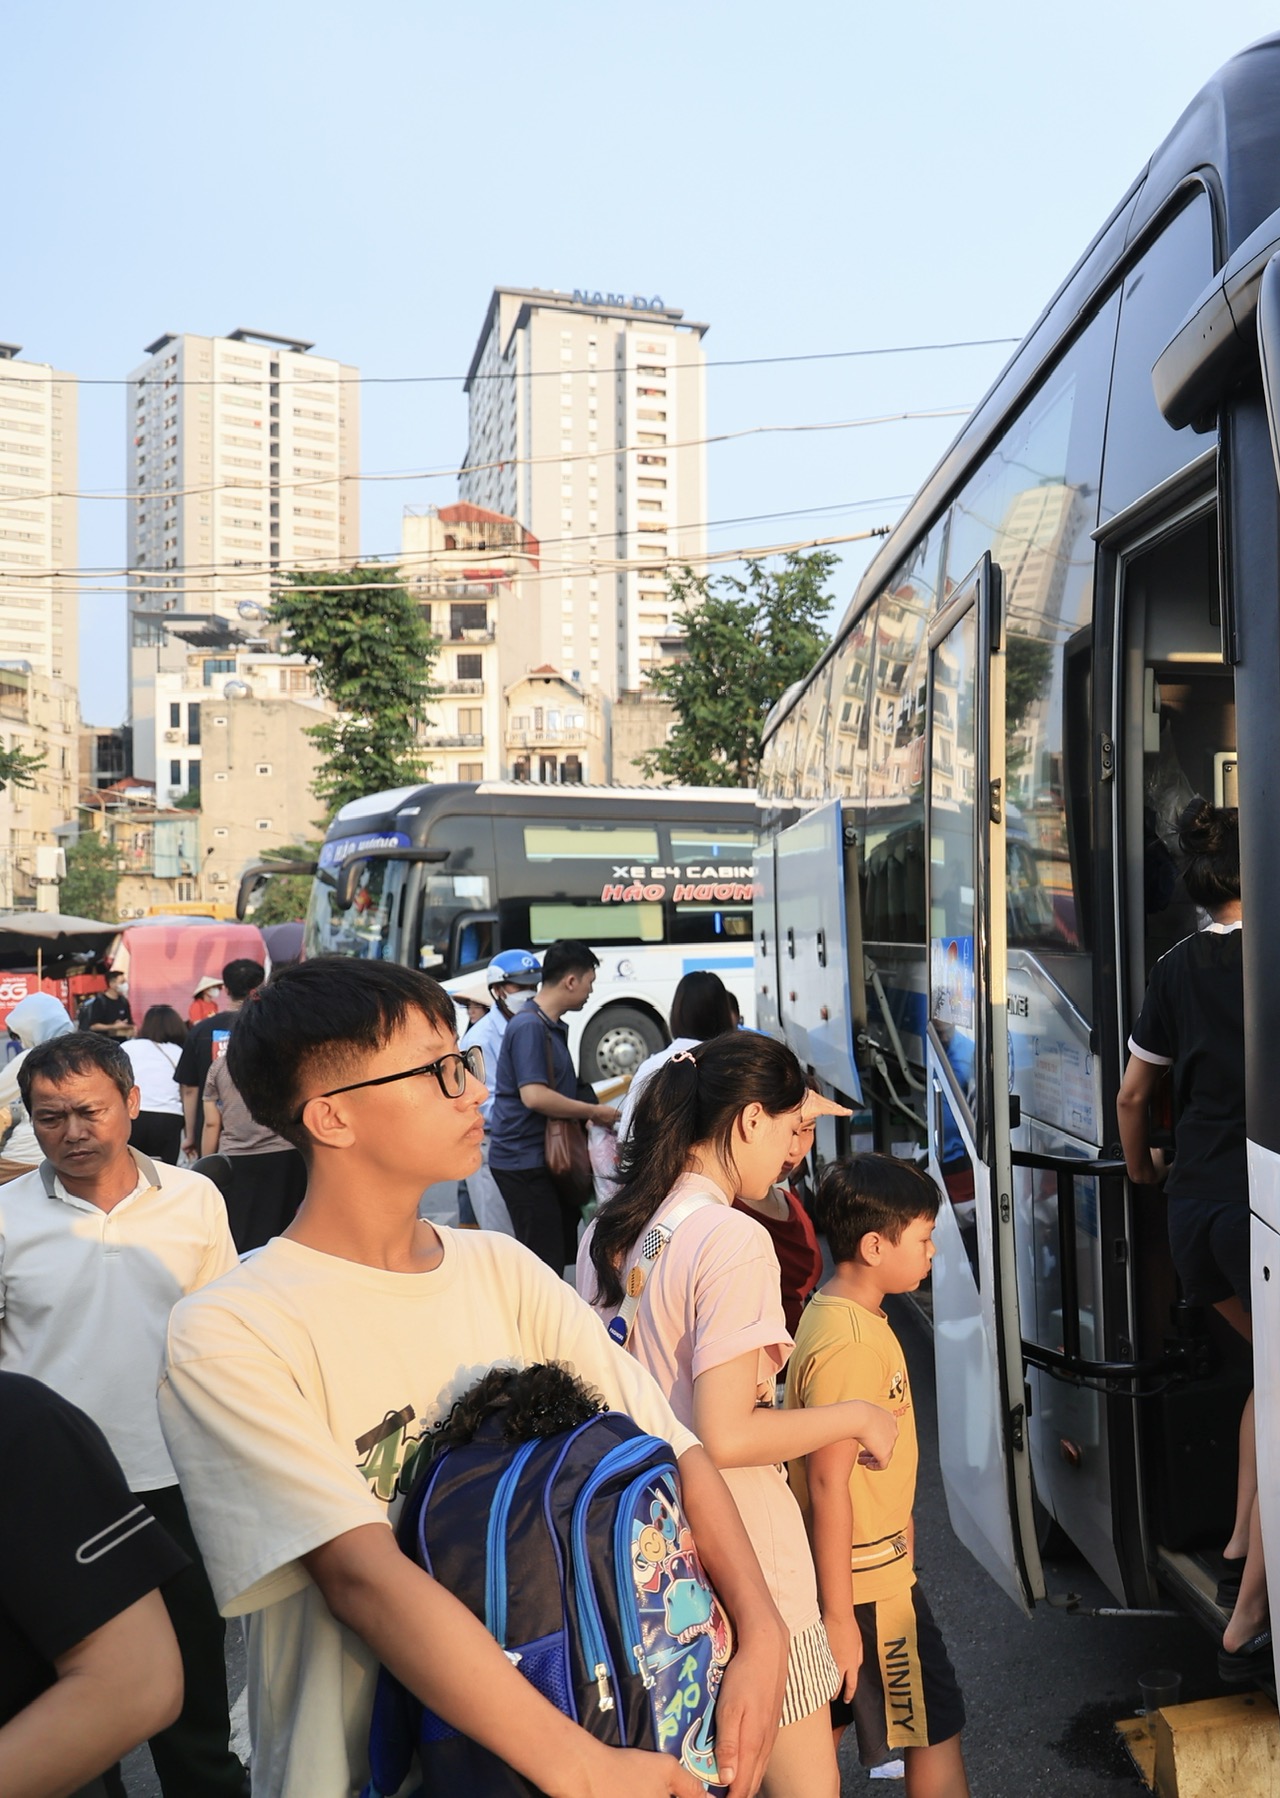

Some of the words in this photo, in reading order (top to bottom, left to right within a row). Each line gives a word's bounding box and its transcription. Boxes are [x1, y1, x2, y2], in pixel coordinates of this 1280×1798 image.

[573, 289, 625, 308] NAM
[612, 866, 646, 879] XE
[651, 866, 681, 879] 24
[686, 866, 756, 879] CABIN
[601, 880, 666, 902] HÀO
[672, 882, 755, 902] HƯƠN
[884, 1637, 915, 1732] NINITY
